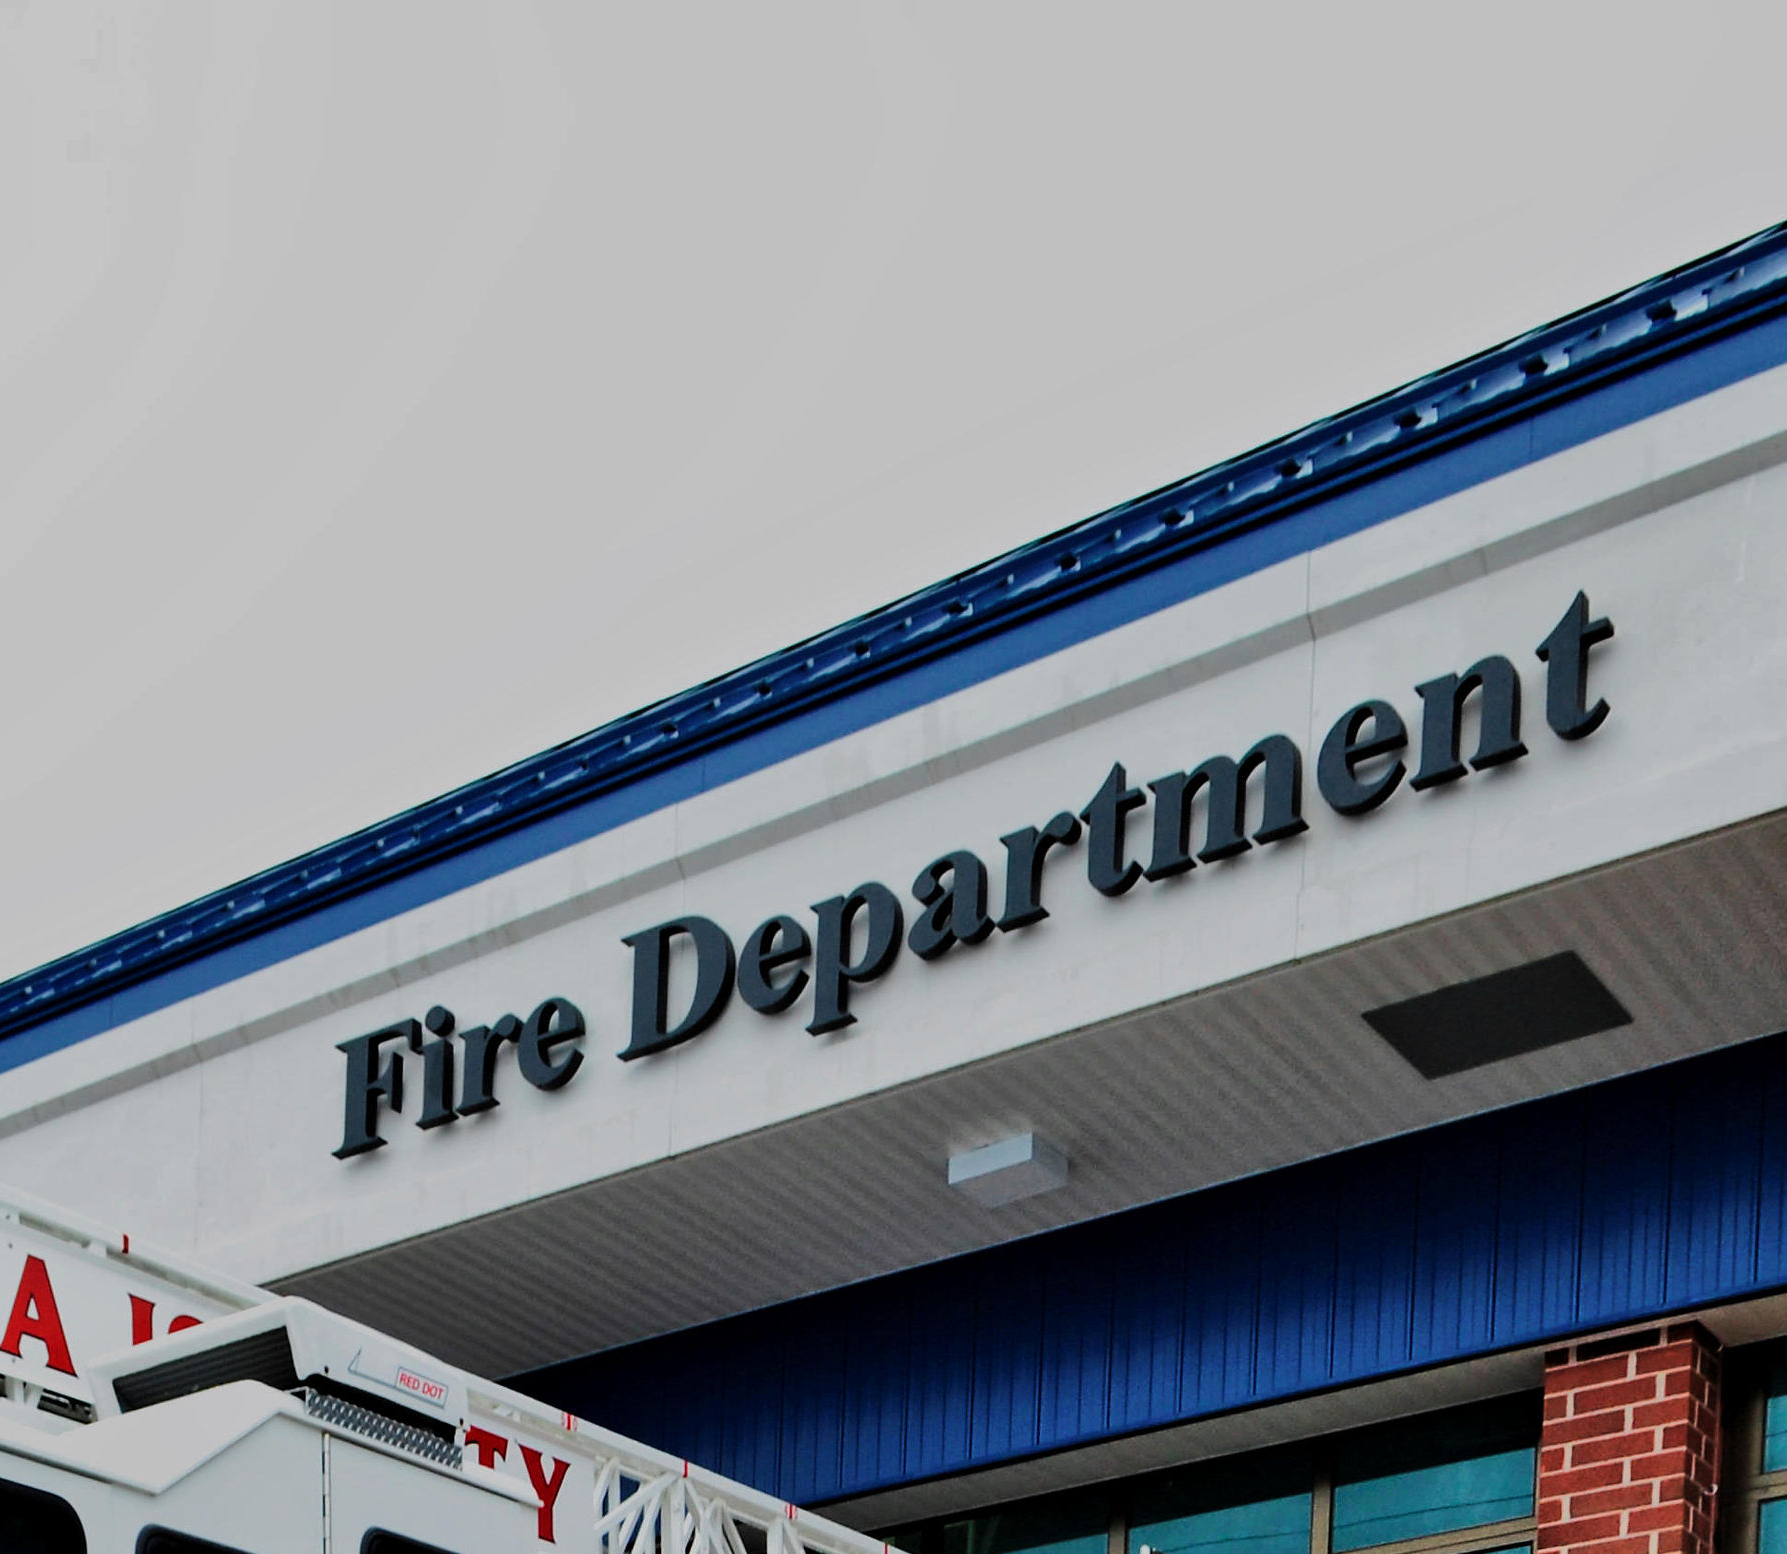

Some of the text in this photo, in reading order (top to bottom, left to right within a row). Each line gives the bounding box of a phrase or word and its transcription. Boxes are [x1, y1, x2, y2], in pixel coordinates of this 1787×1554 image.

[332, 590, 1614, 1160] Fire Department
[399, 1373, 445, 1399] RED DOT
